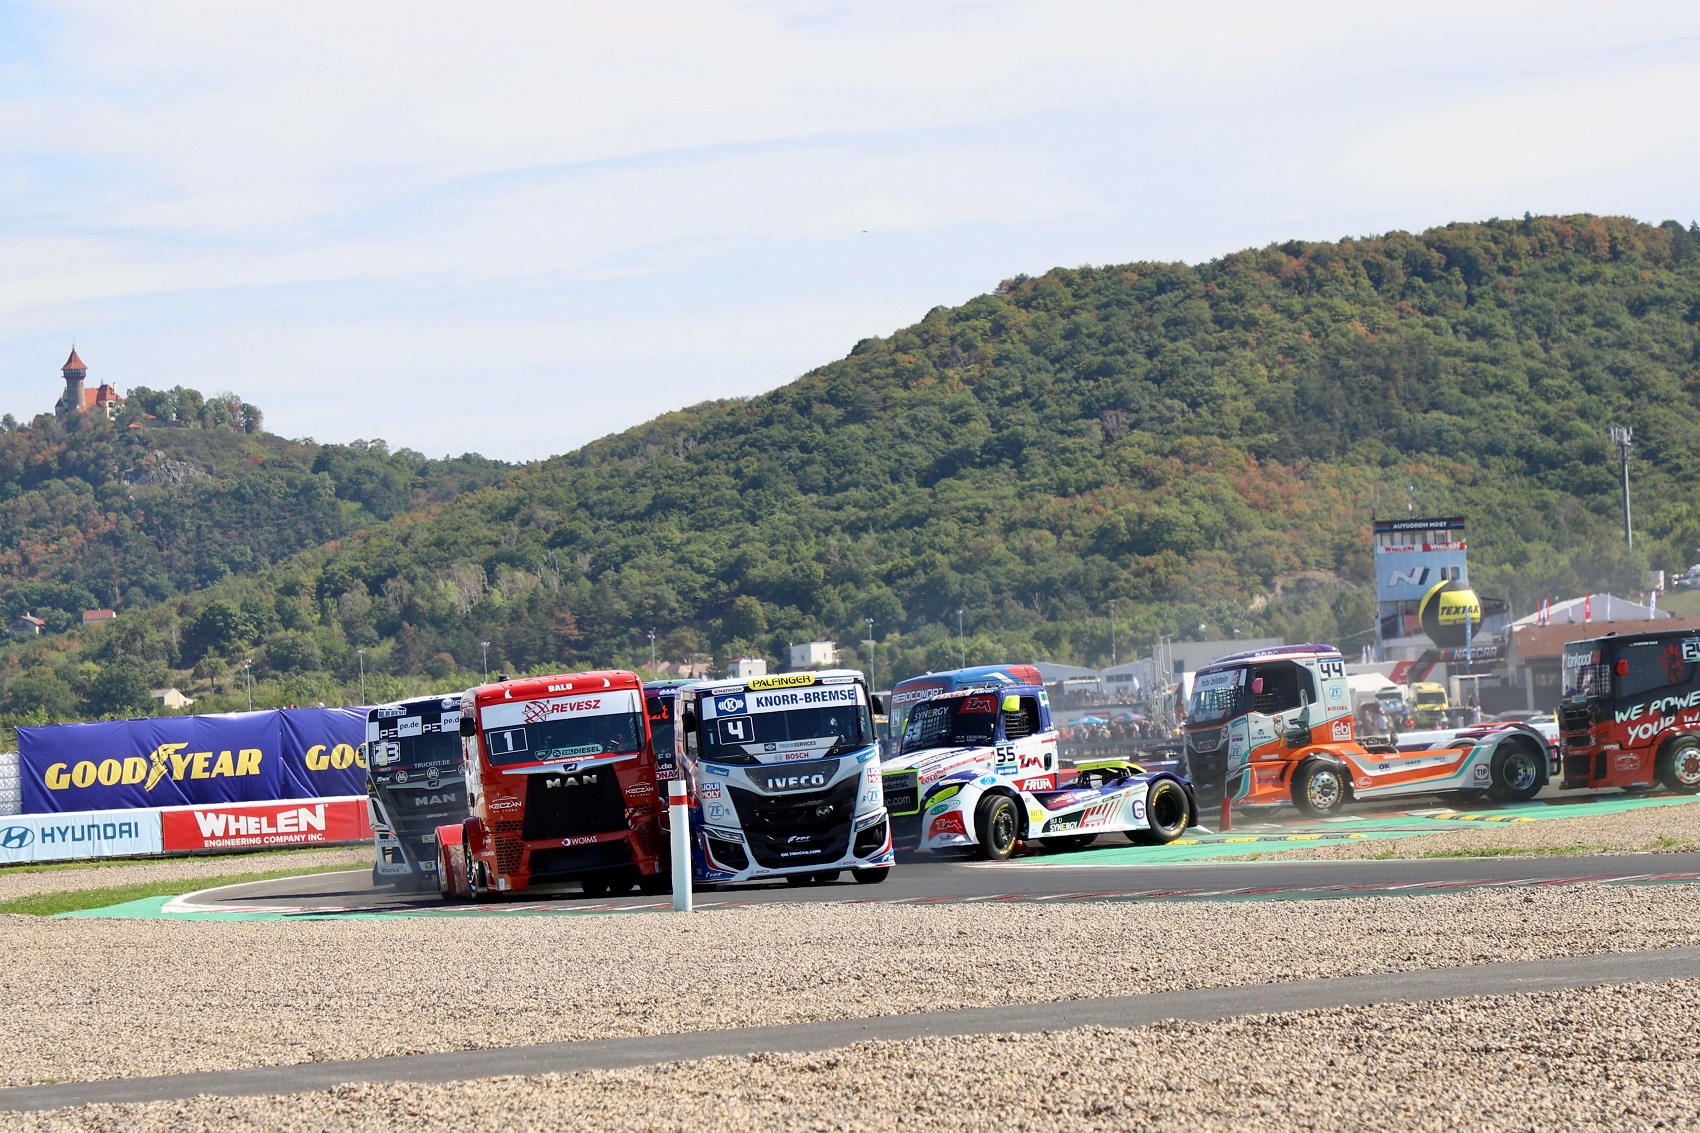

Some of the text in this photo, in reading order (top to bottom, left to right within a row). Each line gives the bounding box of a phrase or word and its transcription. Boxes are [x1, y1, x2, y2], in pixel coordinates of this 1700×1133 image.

[1393, 522, 1429, 530] AUTODROM
[1319, 662, 1344, 678] 44
[548, 683, 573, 693] BALU
[753, 675, 811, 688] PALFINGER
[756, 689, 856, 708] KNORR-BREMSE
[914, 706, 950, 721] SYNERGY
[1615, 703, 1645, 724] WE
[400, 720, 420, 731] pe.de
[728, 720, 745, 740] 4
[1332, 720, 1351, 735] febi
[503, 731, 514, 751] 1
[785, 752, 809, 760] BOSCH
[996, 747, 1016, 763] 55
[44, 747, 263, 791] GOODYEAR
[413, 759, 451, 769] TRUCKFIT.DE
[1476, 768, 1488, 776] TIP
[546, 774, 598, 789] MAN
[767, 774, 825, 789] IVECO
[1022, 778, 1053, 791] FRUM
[415, 793, 457, 806] MAN
[710, 806, 721, 817] ZF
[194, 803, 326, 838] WHELEN
[1049, 820, 1079, 832] SYNERGY
[41, 821, 139, 844] HYUNDAI
[204, 833, 326, 848] ENGINEERING COMPANY INC.
